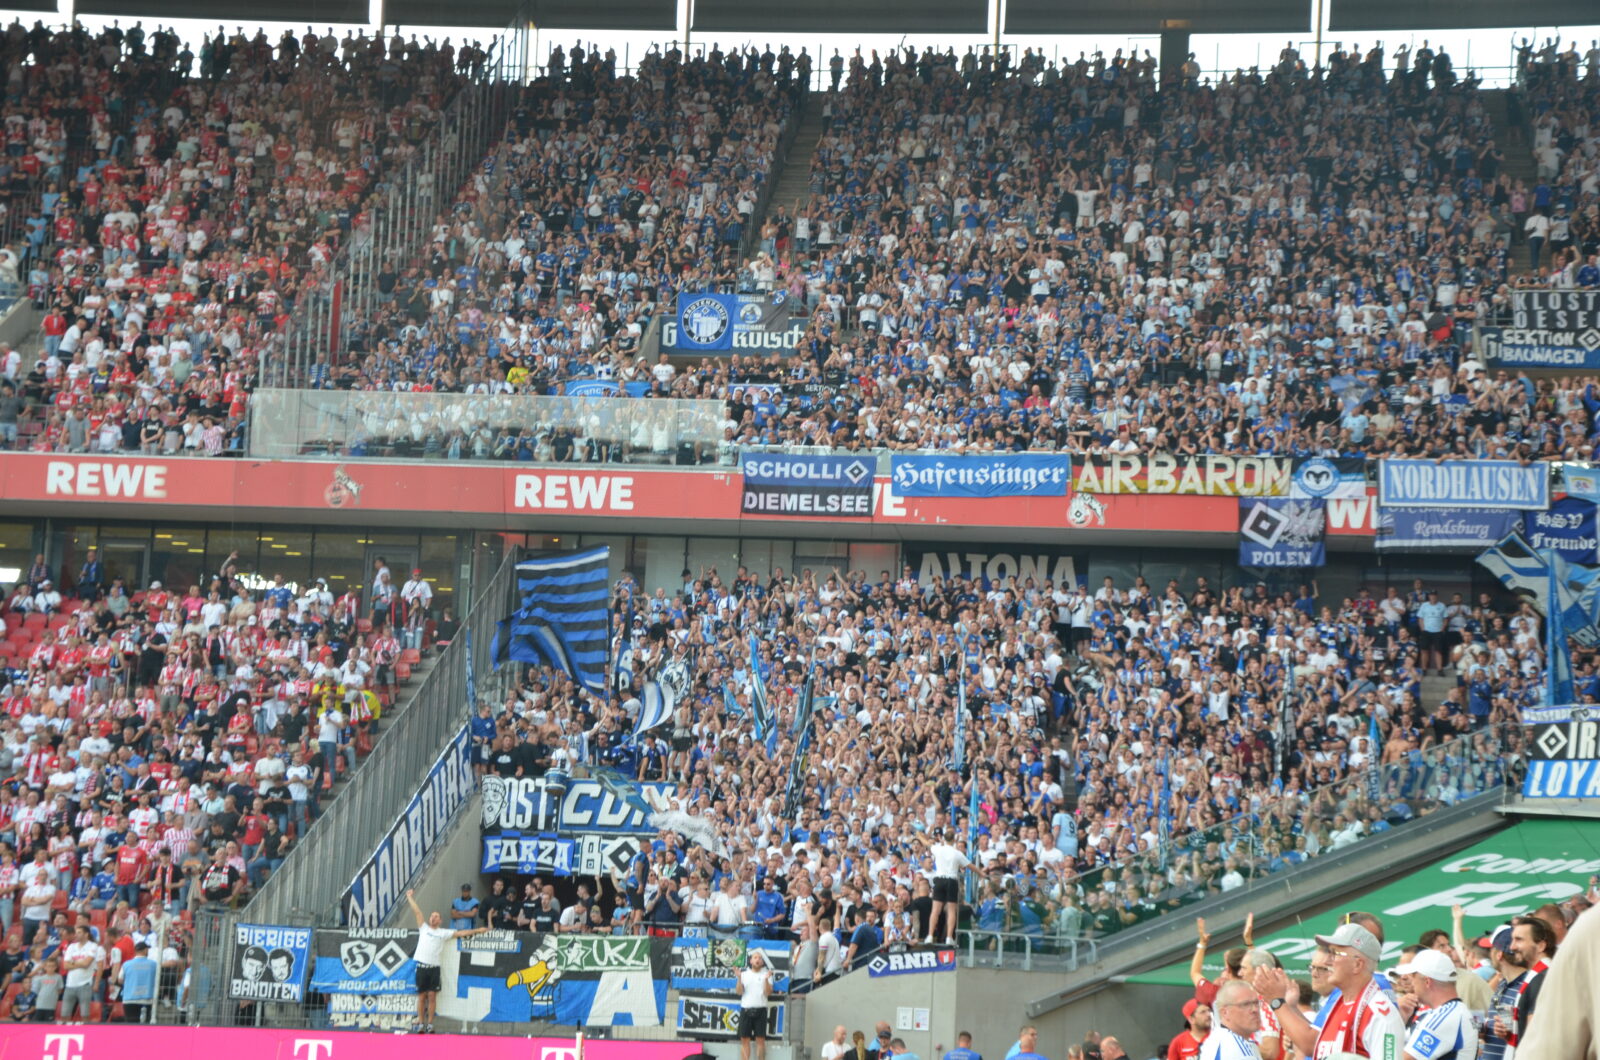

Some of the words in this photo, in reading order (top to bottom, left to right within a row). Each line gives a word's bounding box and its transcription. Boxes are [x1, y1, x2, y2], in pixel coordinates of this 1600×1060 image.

[46, 461, 168, 499] REWE
[745, 461, 842, 479] SCHOLLI
[893, 457, 1066, 492] Hafensänger
[515, 475, 635, 510] REWE
[1389, 464, 1541, 502] NORDHAUSEN
[744, 492, 870, 513] DIEMELSEE
[1413, 519, 1490, 538] Rendsburg
[1530, 532, 1598, 550] Freunde
[1251, 551, 1312, 567] POLEN
[484, 839, 572, 872] FORZA
[1383, 881, 1585, 917] FC
[237, 929, 309, 949] BIERIGE
[348, 928, 408, 939] HAMBURG
[888, 951, 938, 972] RNR
[231, 979, 301, 999] BANDITEN
[338, 980, 406, 991] HOOLIGANS
